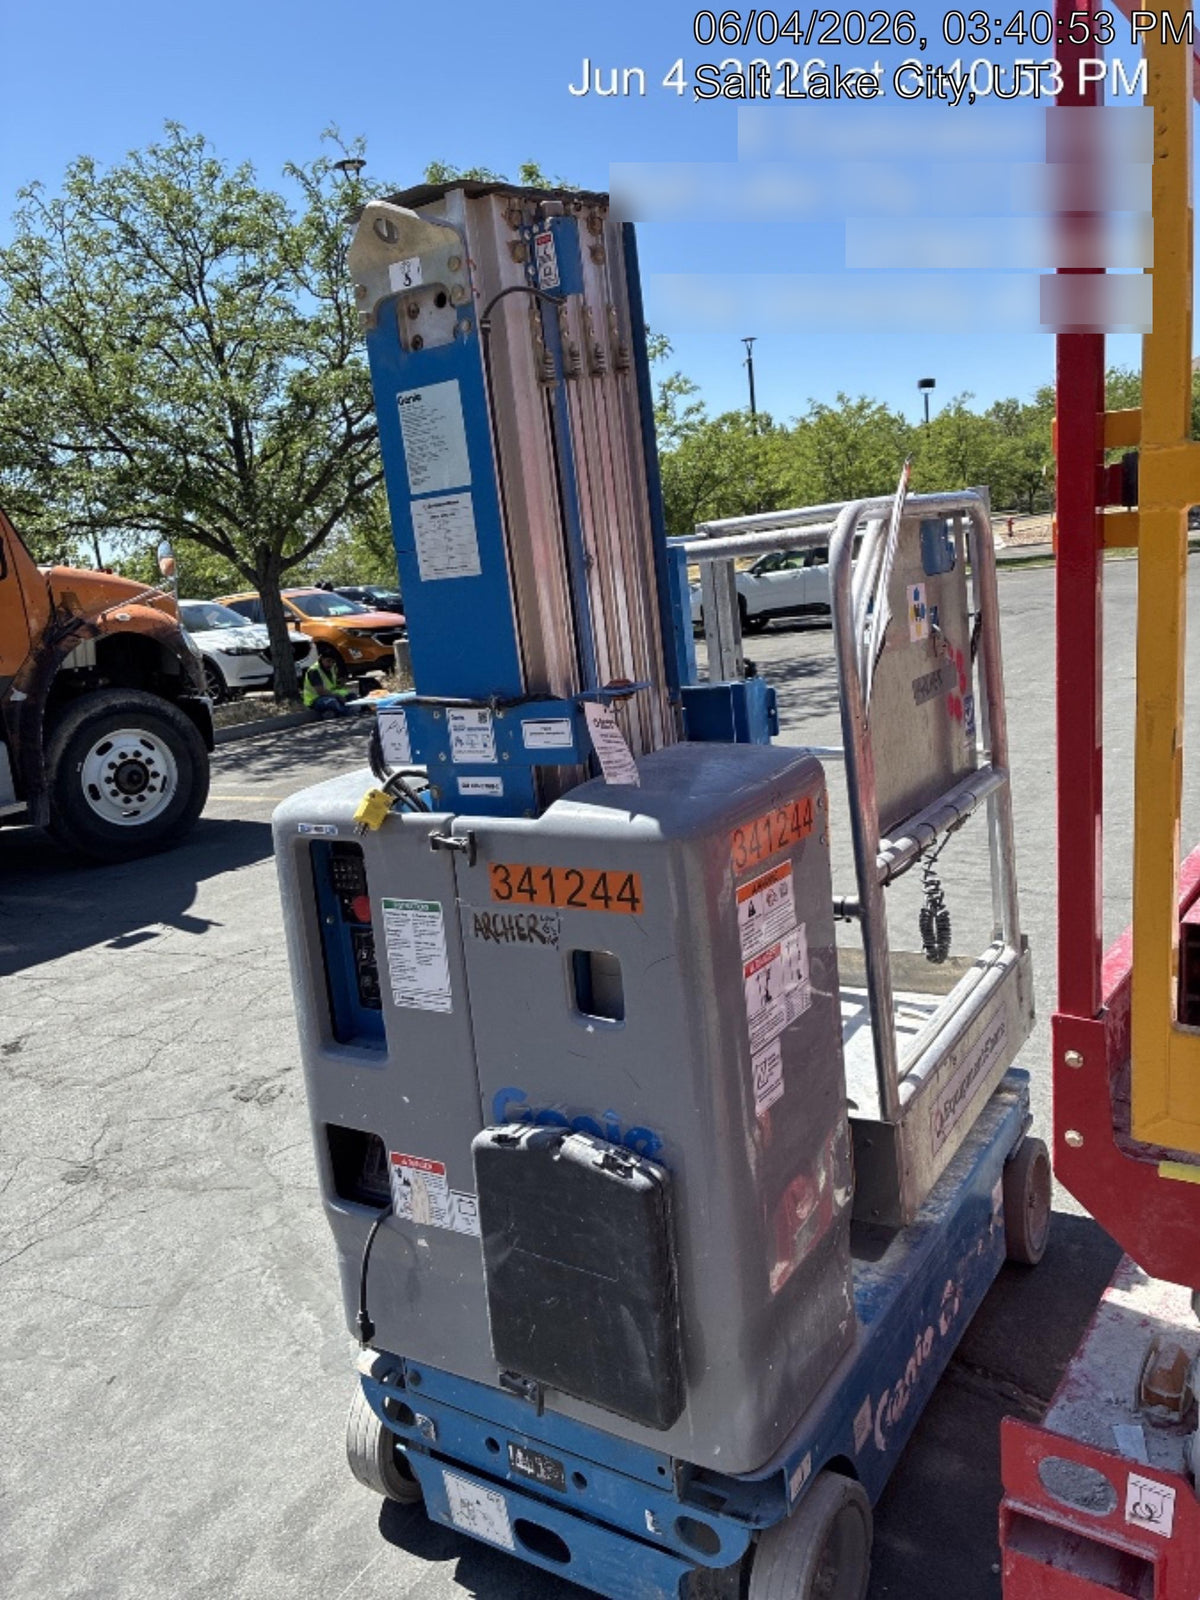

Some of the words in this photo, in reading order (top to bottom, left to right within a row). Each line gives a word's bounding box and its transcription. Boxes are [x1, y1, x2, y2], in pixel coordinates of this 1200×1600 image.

[734, 799, 813, 868] 341244
[491, 863, 641, 912] 341244
[473, 911, 546, 945] ARCHER
